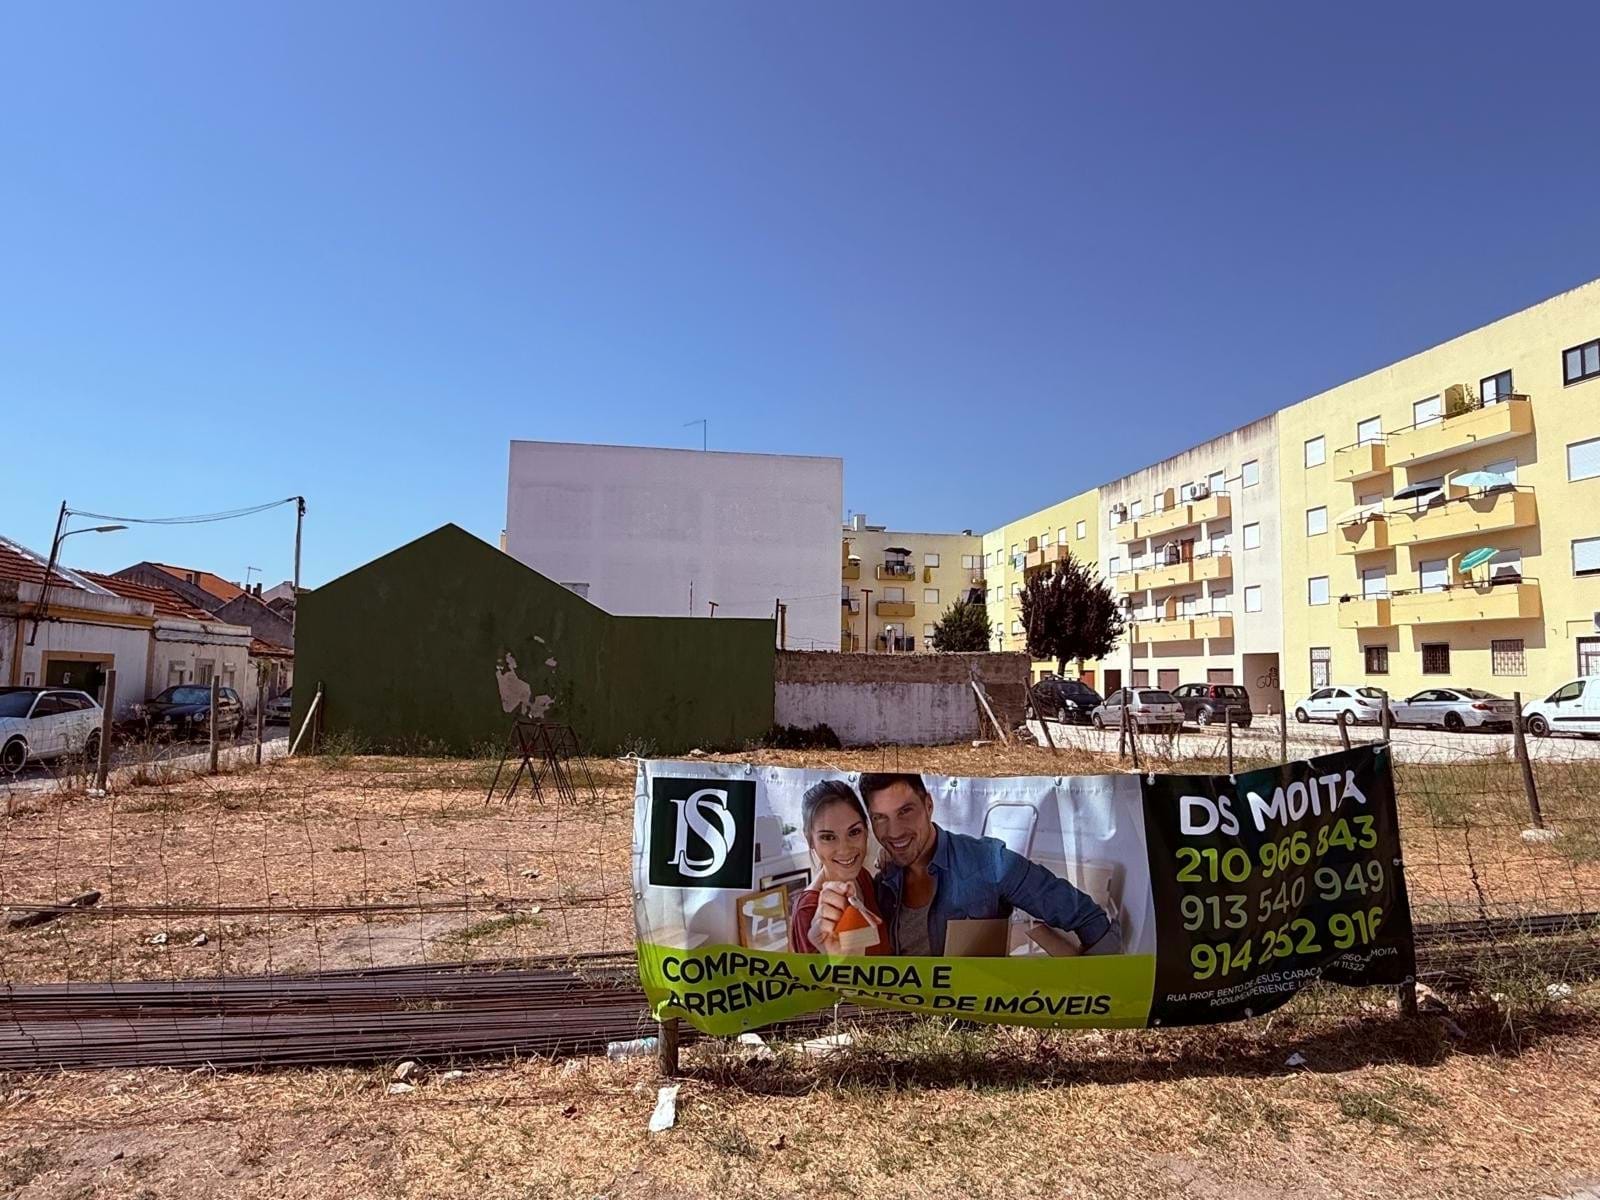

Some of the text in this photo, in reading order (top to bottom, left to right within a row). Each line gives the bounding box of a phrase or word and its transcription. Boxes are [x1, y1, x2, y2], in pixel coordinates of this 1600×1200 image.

[1179, 769, 1367, 836] DS MOITA
[1175, 814, 1378, 883] 210 966 843
[1180, 859, 1385, 931] 913 540 949
[662, 952, 953, 989] COMPRA, VENDA E
[1166, 993, 1187, 1002] RUA
[1217, 984, 1244, 997] BENTO
[1244, 979, 1255, 989] DE
[1254, 971, 1282, 986] JESUS
[1371, 946, 1399, 957] MOITA
[1190, 939, 1252, 980] 914
[1258, 918, 1323, 965] 252
[667, 979, 1112, 1017] ARRENDAMENTO DE IMÓVEIS
